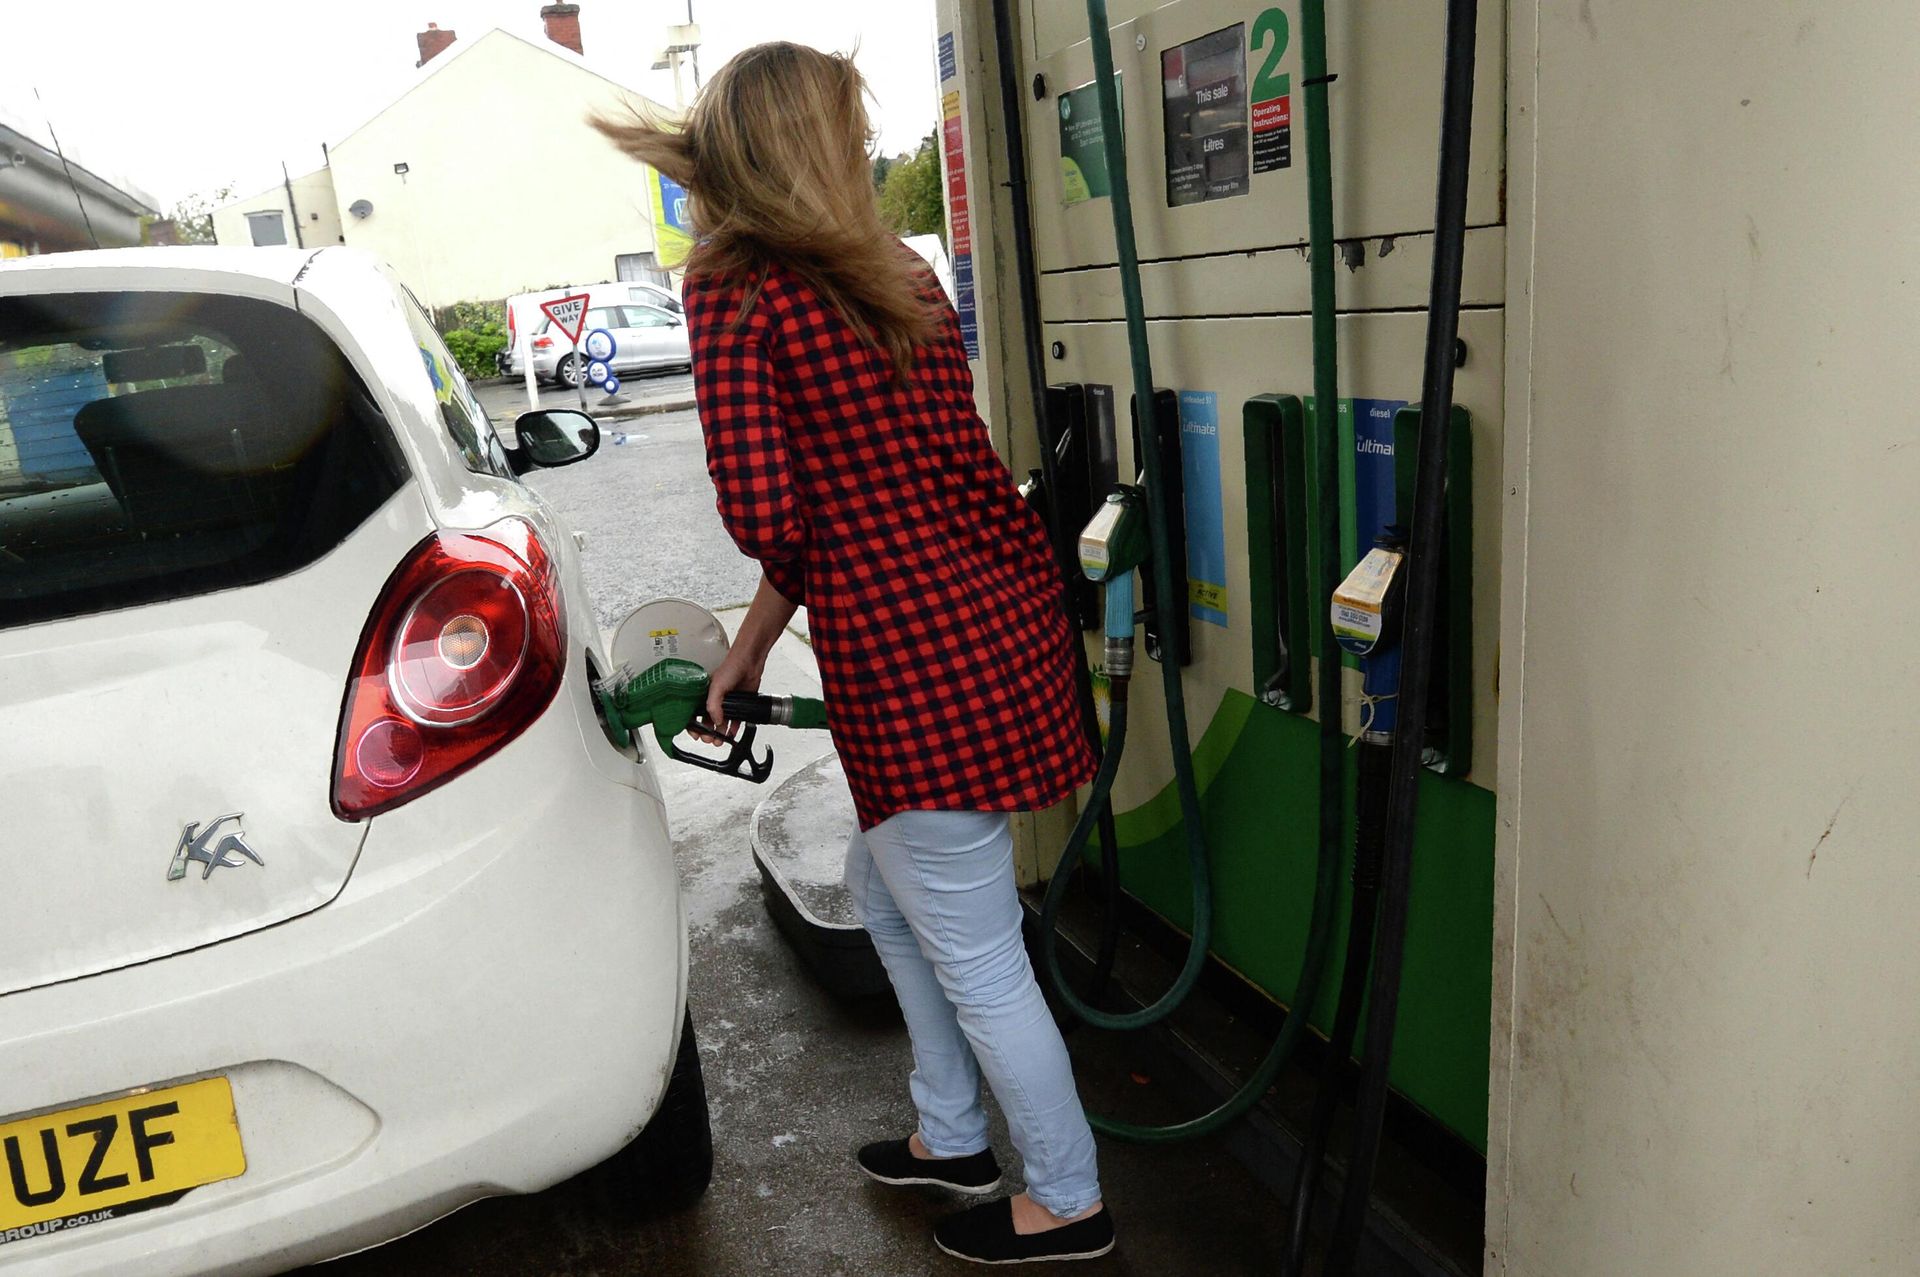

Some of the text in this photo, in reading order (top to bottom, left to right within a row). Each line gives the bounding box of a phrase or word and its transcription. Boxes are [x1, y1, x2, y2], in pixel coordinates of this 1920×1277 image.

[1250, 7, 1290, 103] 2
[1196, 84, 1229, 105] This sale
[1253, 104, 1281, 117] Operating
[1253, 113, 1289, 128] Instructions:
[1203, 138, 1225, 152] Litres
[552, 301, 581, 316] GIVE
[559, 313, 579, 324] WAY
[1338, 403, 1348, 413] 95
[1369, 407, 1391, 419] diesel
[1183, 421, 1216, 436] ultimate
[3, 1100, 180, 1207] UZF
